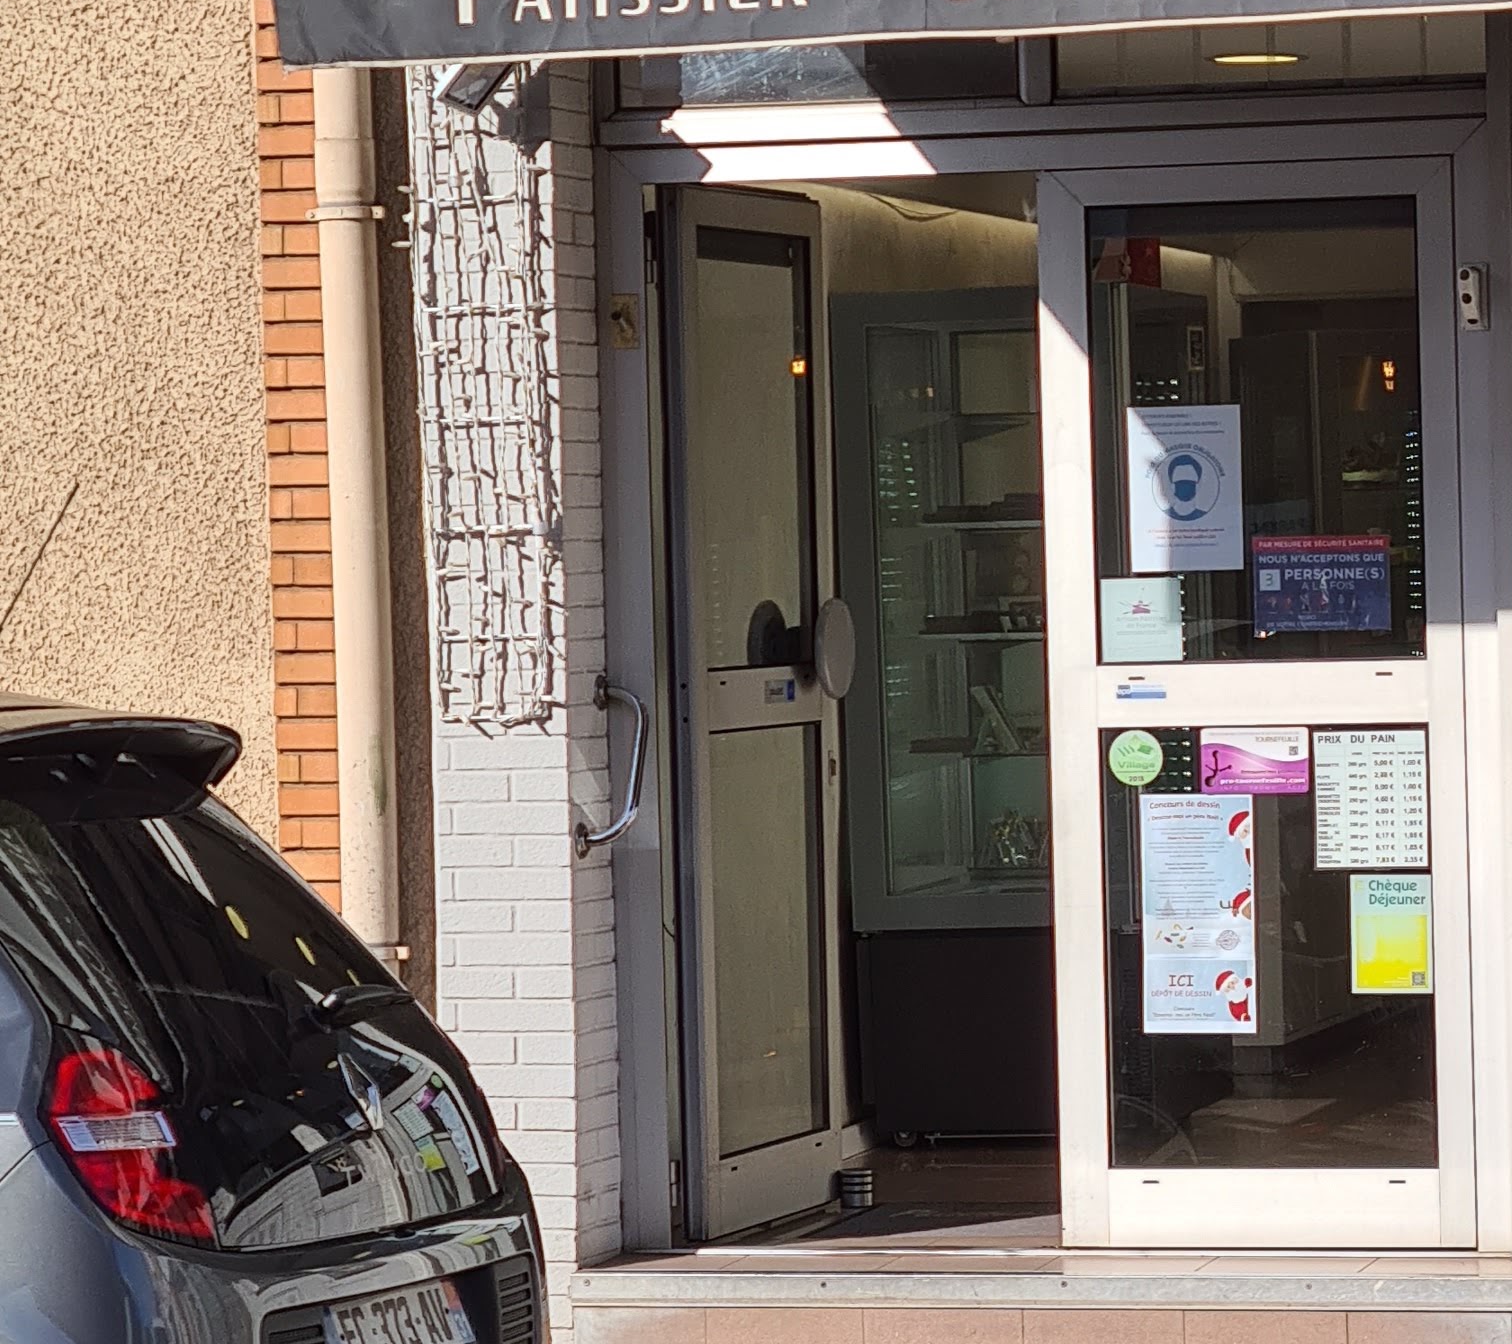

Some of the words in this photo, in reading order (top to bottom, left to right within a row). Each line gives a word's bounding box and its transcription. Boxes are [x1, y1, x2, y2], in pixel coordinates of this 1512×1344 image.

[1275, 540, 1301, 548] MESURE
[1314, 538, 1347, 547] SÉCURITÉ
[1348, 538, 1384, 546] SANITAIRE
[1258, 555, 1288, 564] NOUS
[1290, 554, 1360, 563] N'ACCEPTONS
[1362, 553, 1385, 562] QUE
[1264, 573, 1274, 586] 3
[1284, 567, 1385, 581] PERSONNE(S)
[1329, 581, 1355, 591] FOIS
[1317, 735, 1341, 744] PRIX
[1350, 734, 1364, 743] DU
[1370, 734, 1395, 743] PAIN
[1118, 761, 1155, 770] Village
[1149, 801, 1184, 809] Concours
[1197, 801, 1221, 809] dessin
[1368, 879, 1418, 894] Chèque
[1369, 893, 1426, 908] Déjeuner
[1168, 975, 1195, 987] ICI
